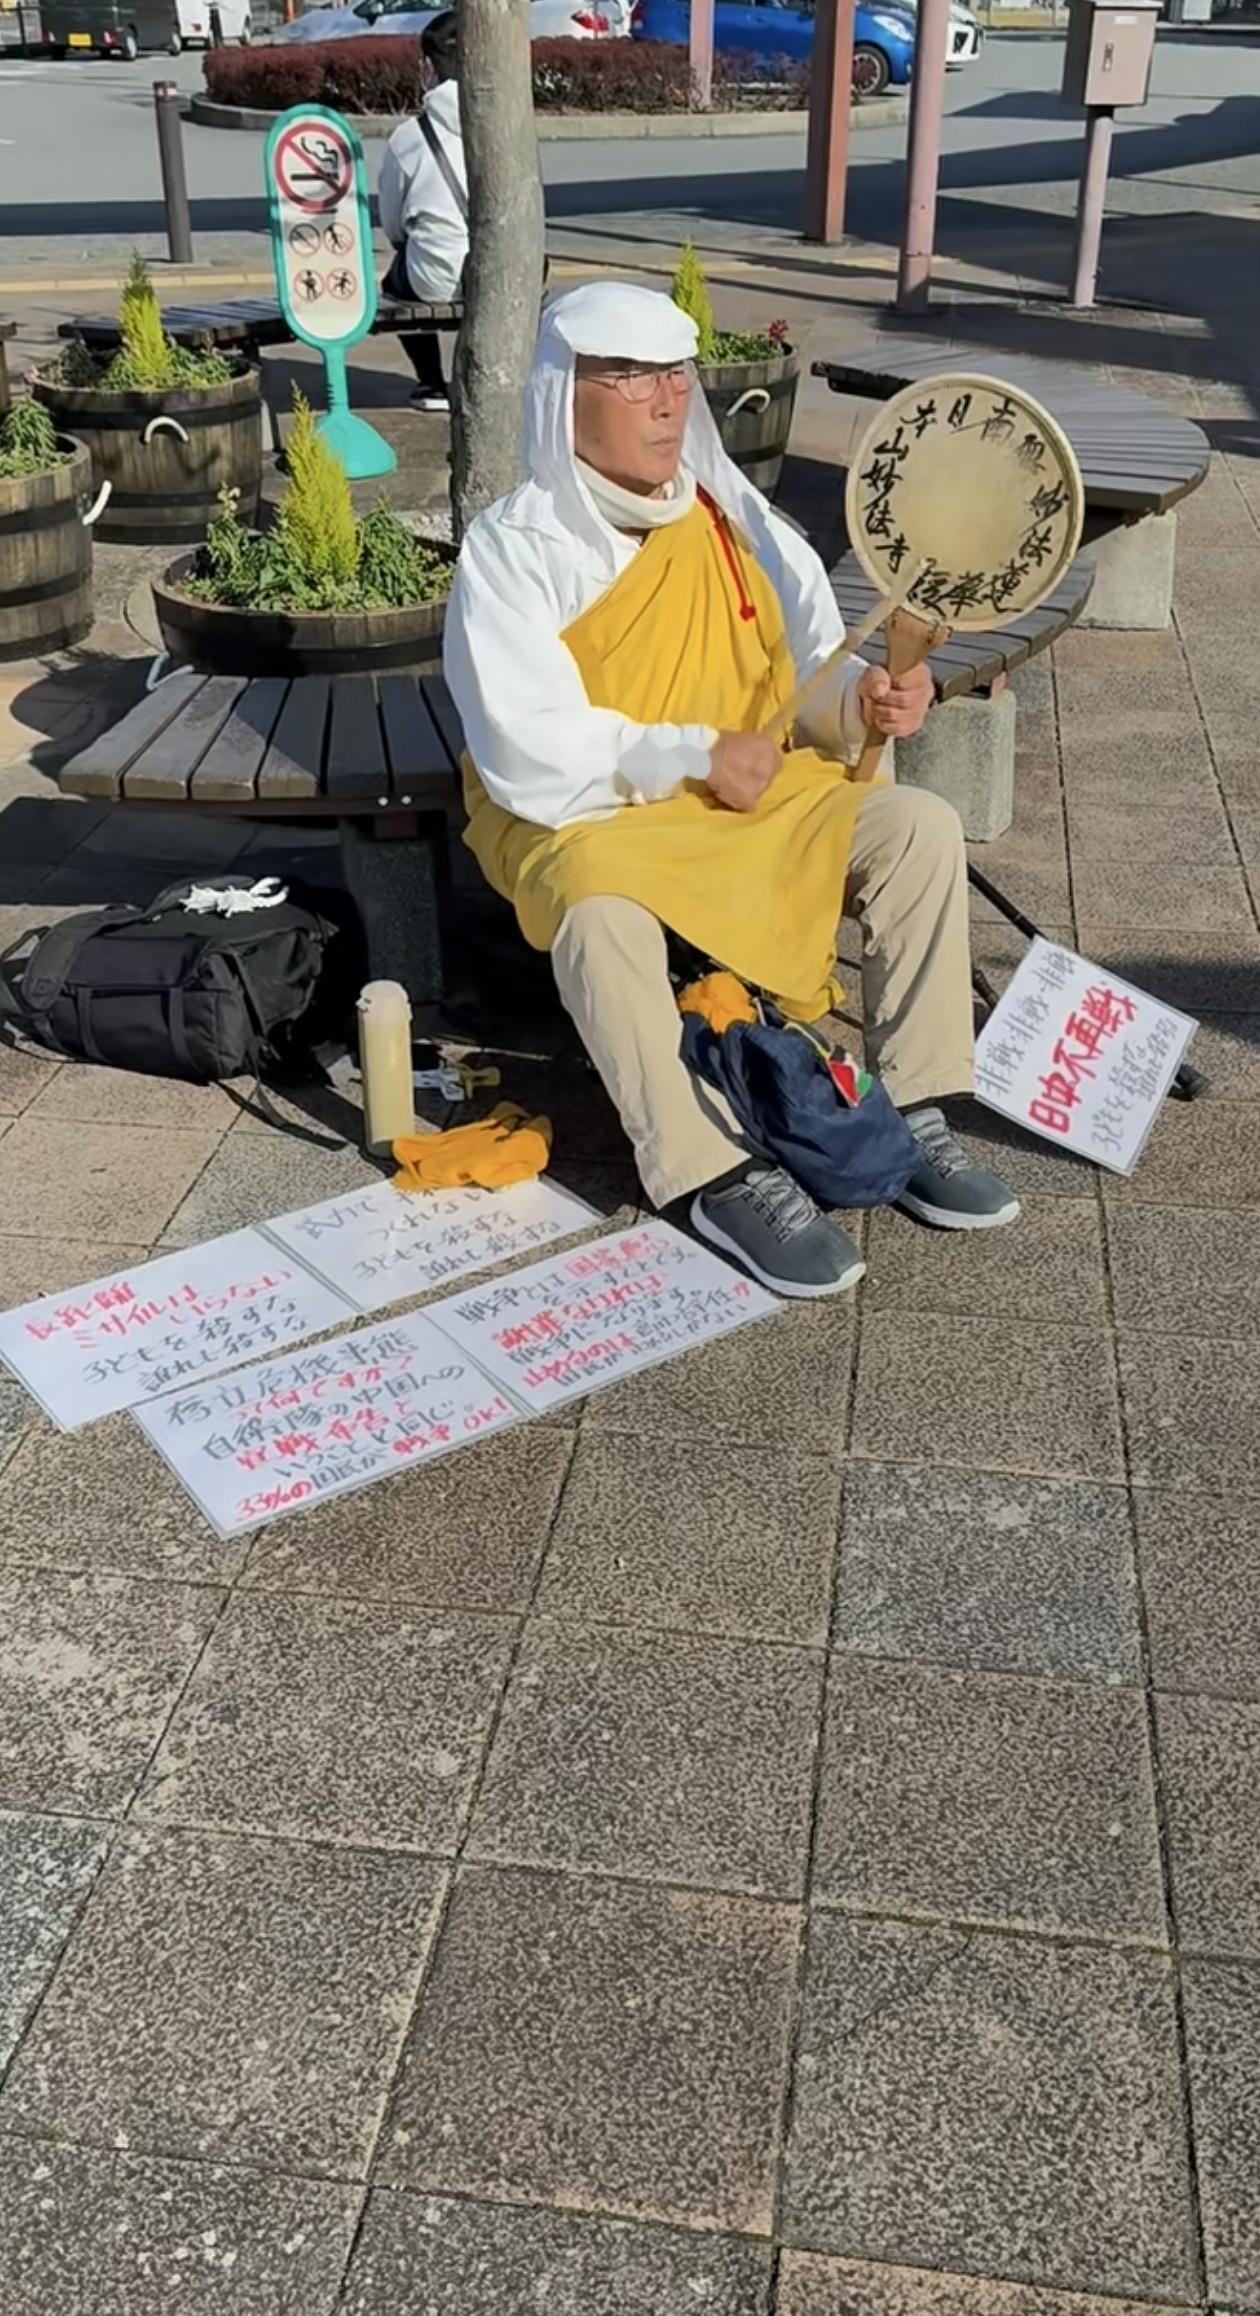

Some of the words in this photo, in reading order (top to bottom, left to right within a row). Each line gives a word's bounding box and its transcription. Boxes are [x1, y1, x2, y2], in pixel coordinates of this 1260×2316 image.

[1027, 983, 1138, 1134] 日中不再戦
[168, 1331, 419, 1426] 存立危機事態
